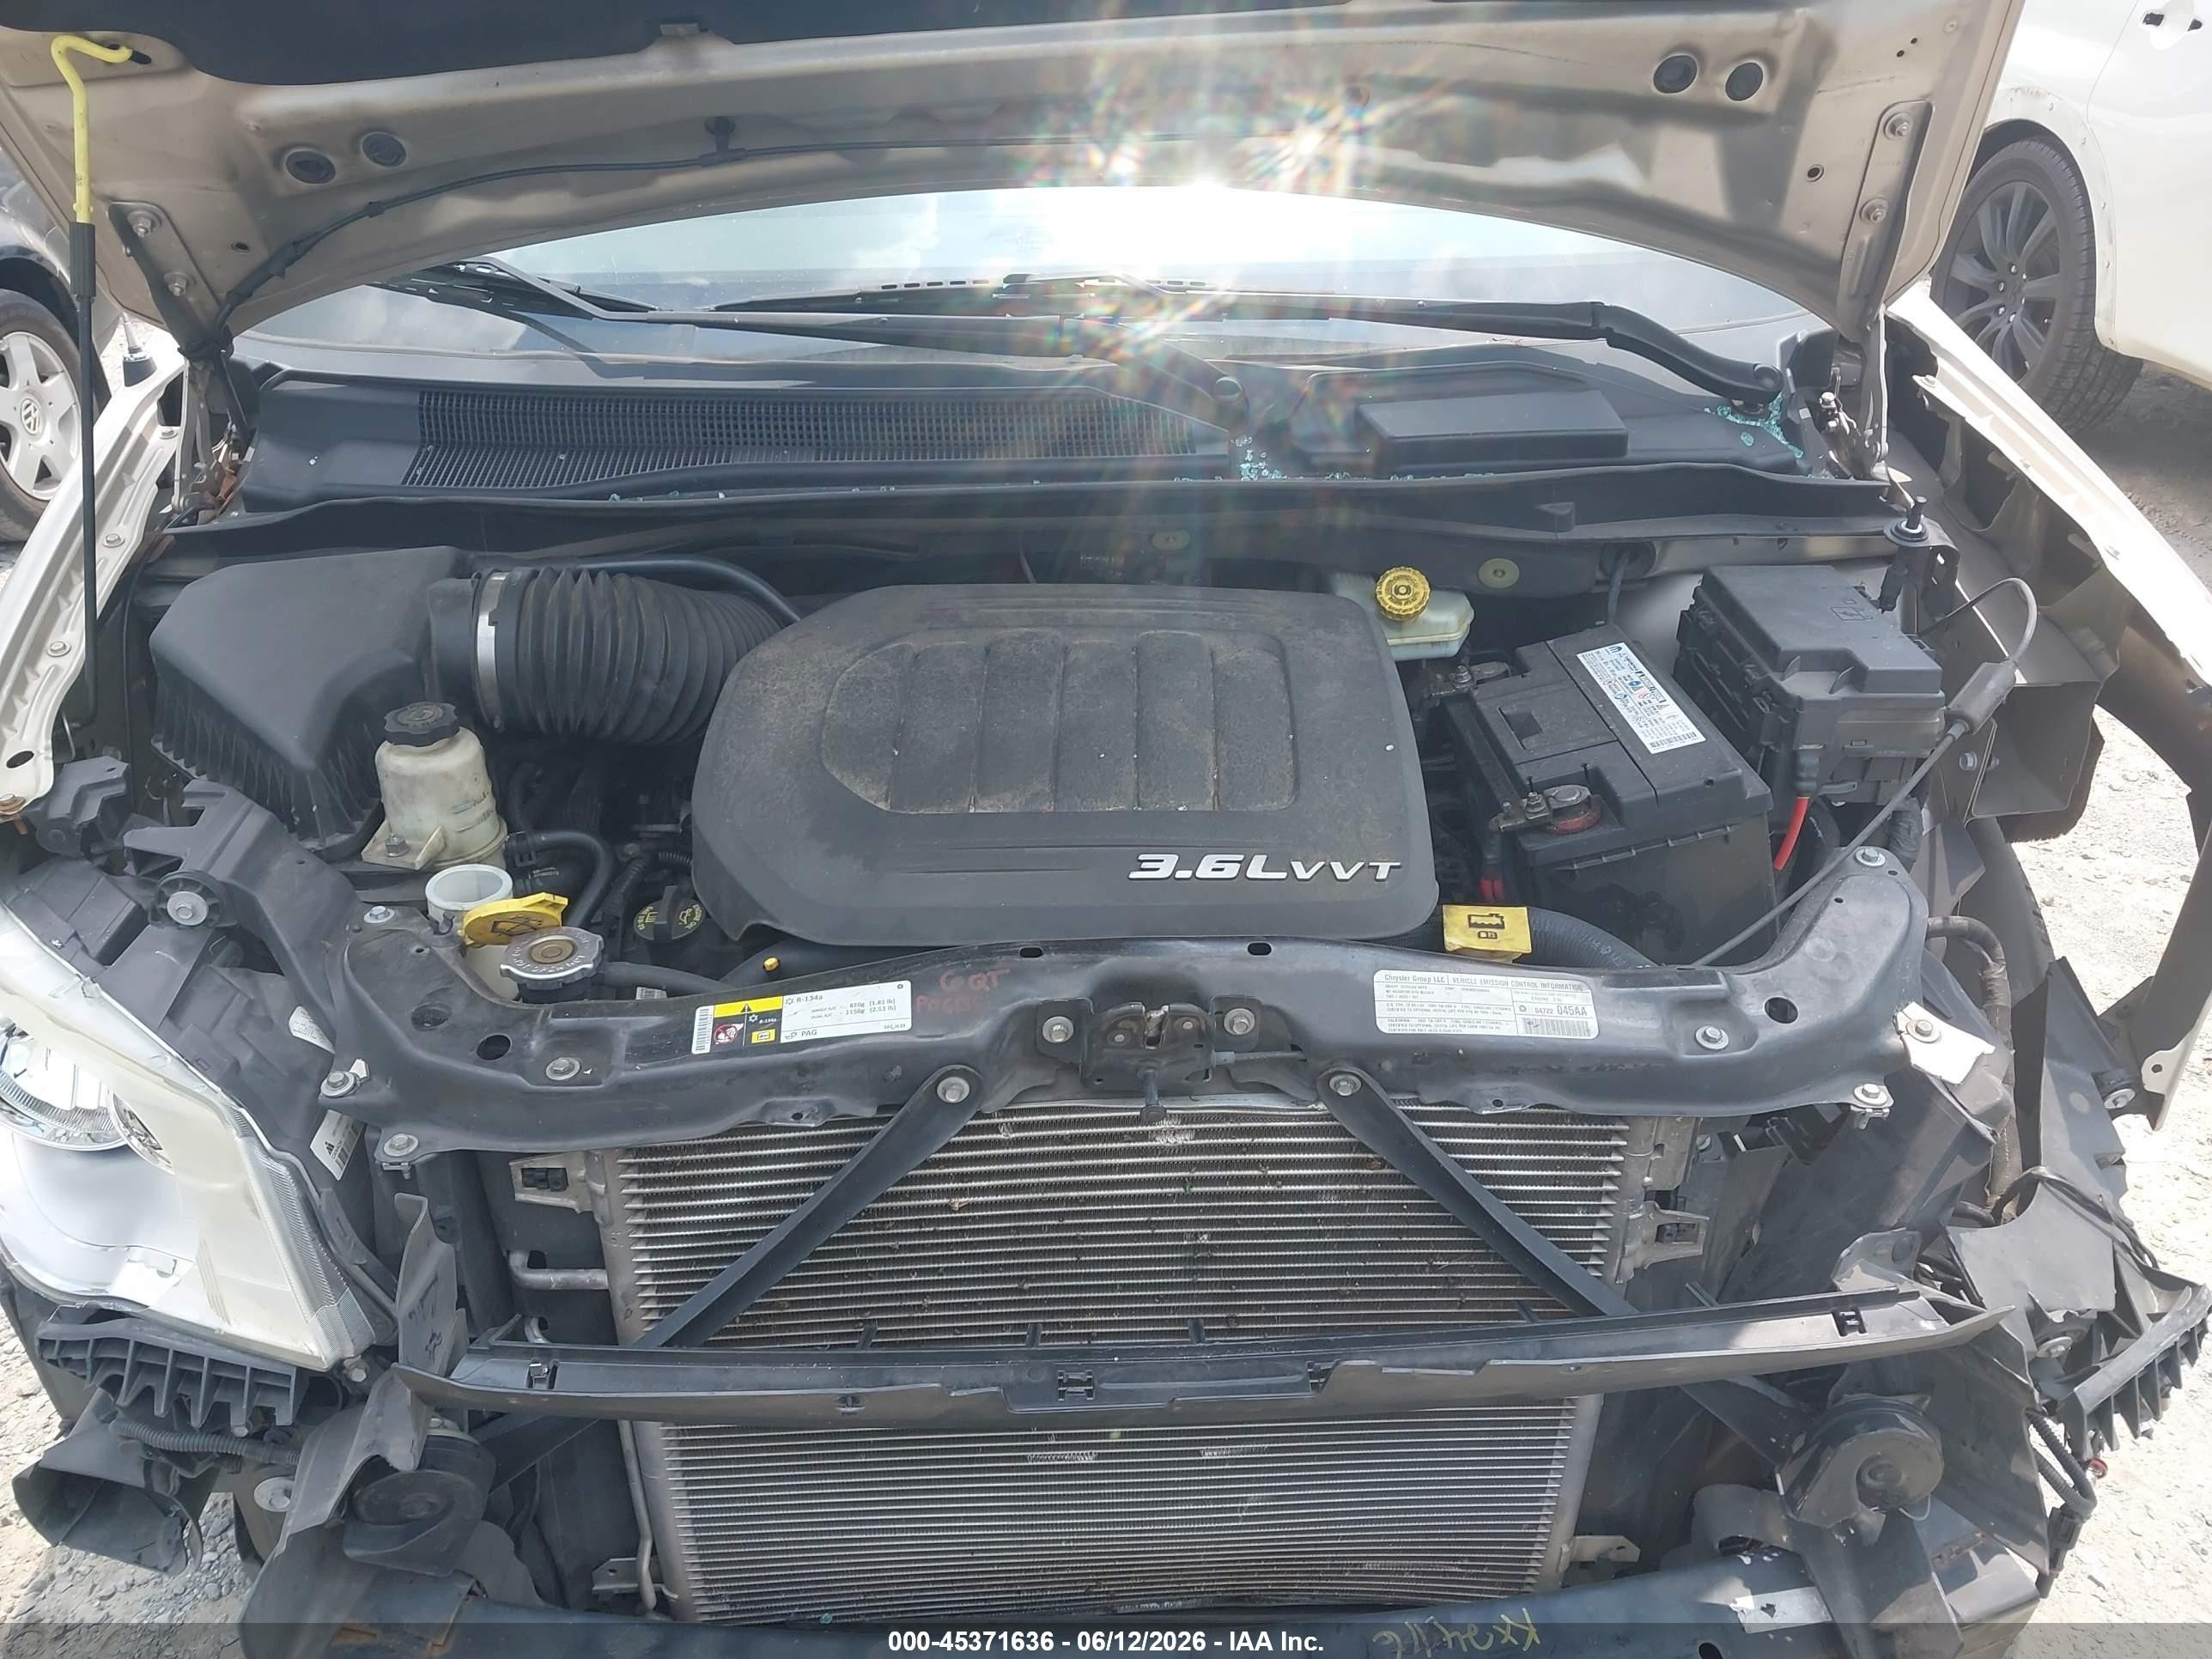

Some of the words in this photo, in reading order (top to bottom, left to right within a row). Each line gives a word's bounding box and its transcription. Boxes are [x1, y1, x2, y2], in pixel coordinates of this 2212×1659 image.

[1384, 974, 1411, 984] Chrysler
[1412, 975, 1432, 985] Group
[1434, 975, 1446, 984] LLC
[1452, 977, 1479, 986] VEHICLE
[1480, 978, 1510, 987] EMISSION
[1510, 980, 1540, 988] CONTROL
[1540, 981, 1583, 992] INFORMATION
[795, 993, 824, 1005] R-134a
[800, 1029, 818, 1039] PAG
